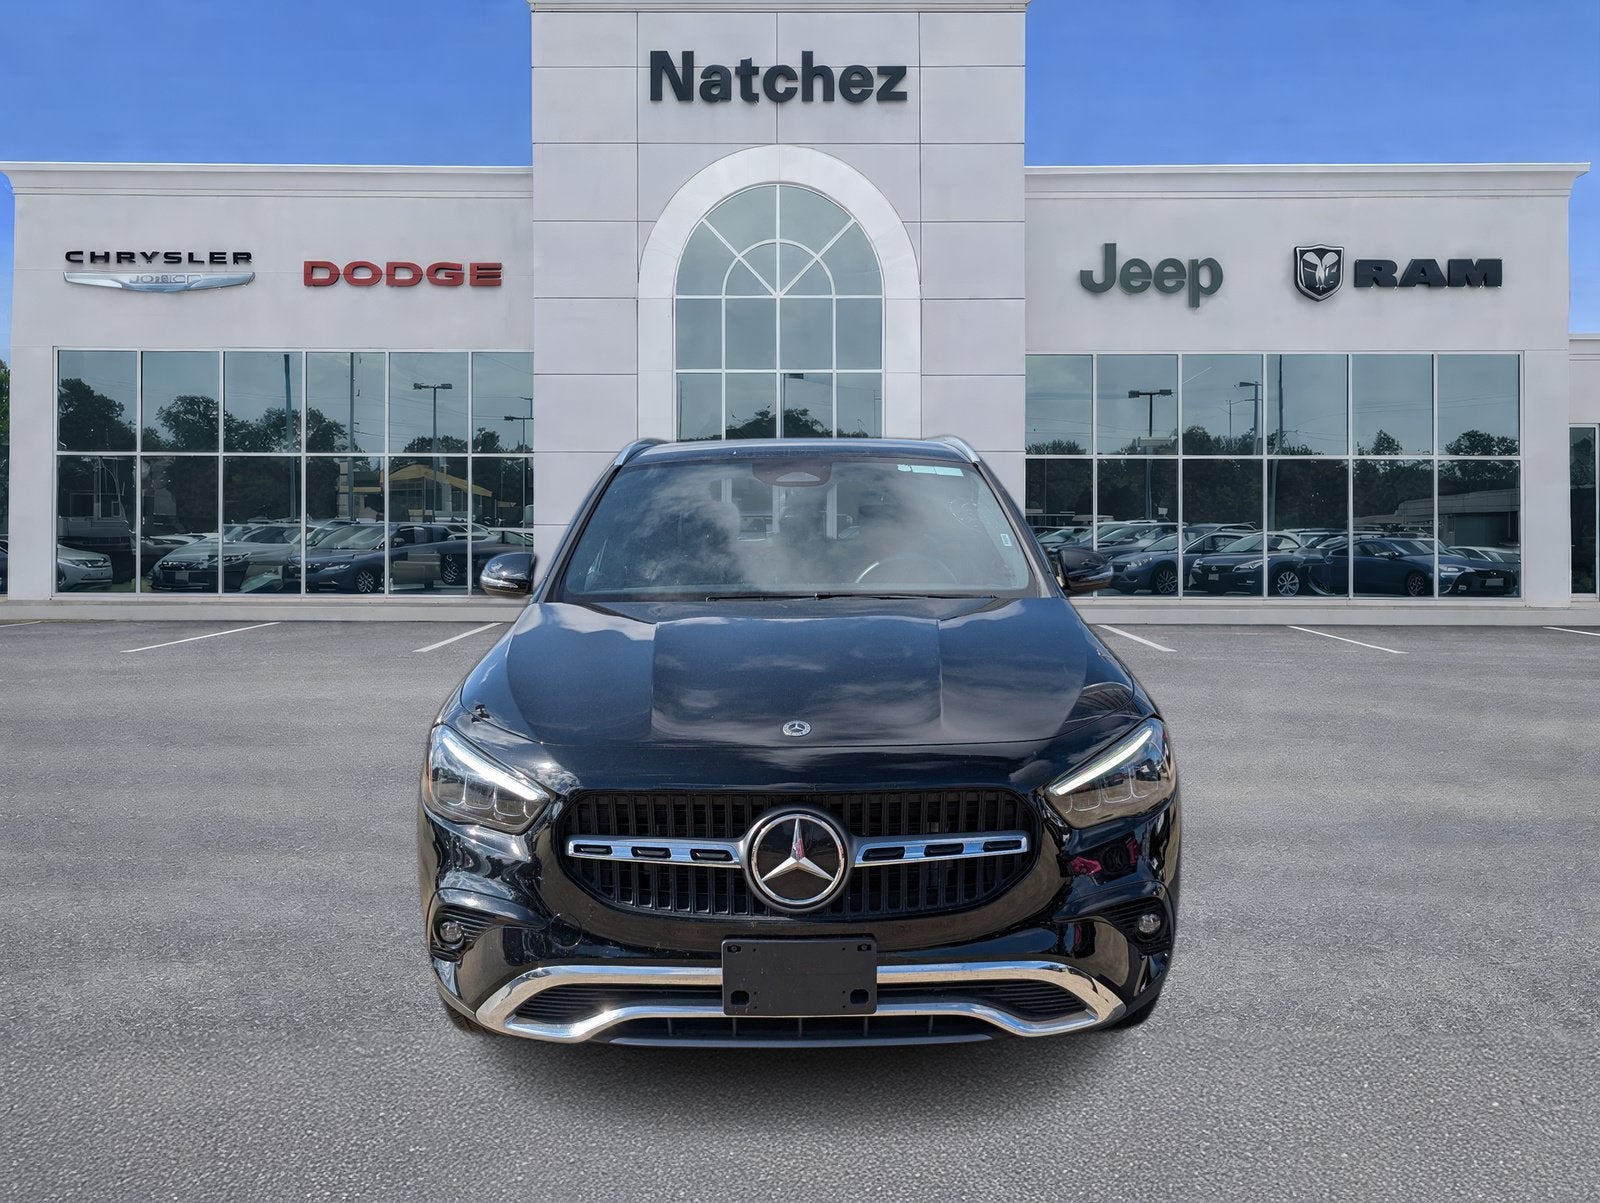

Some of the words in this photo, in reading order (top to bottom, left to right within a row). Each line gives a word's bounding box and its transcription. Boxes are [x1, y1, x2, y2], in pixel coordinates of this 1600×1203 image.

[650, 50, 908, 103] Natchez
[64, 250, 252, 265] CHRYSLER
[303, 260, 503, 287] DODGE
[1080, 243, 1224, 308] Jeep
[1354, 259, 1503, 288] RAM
